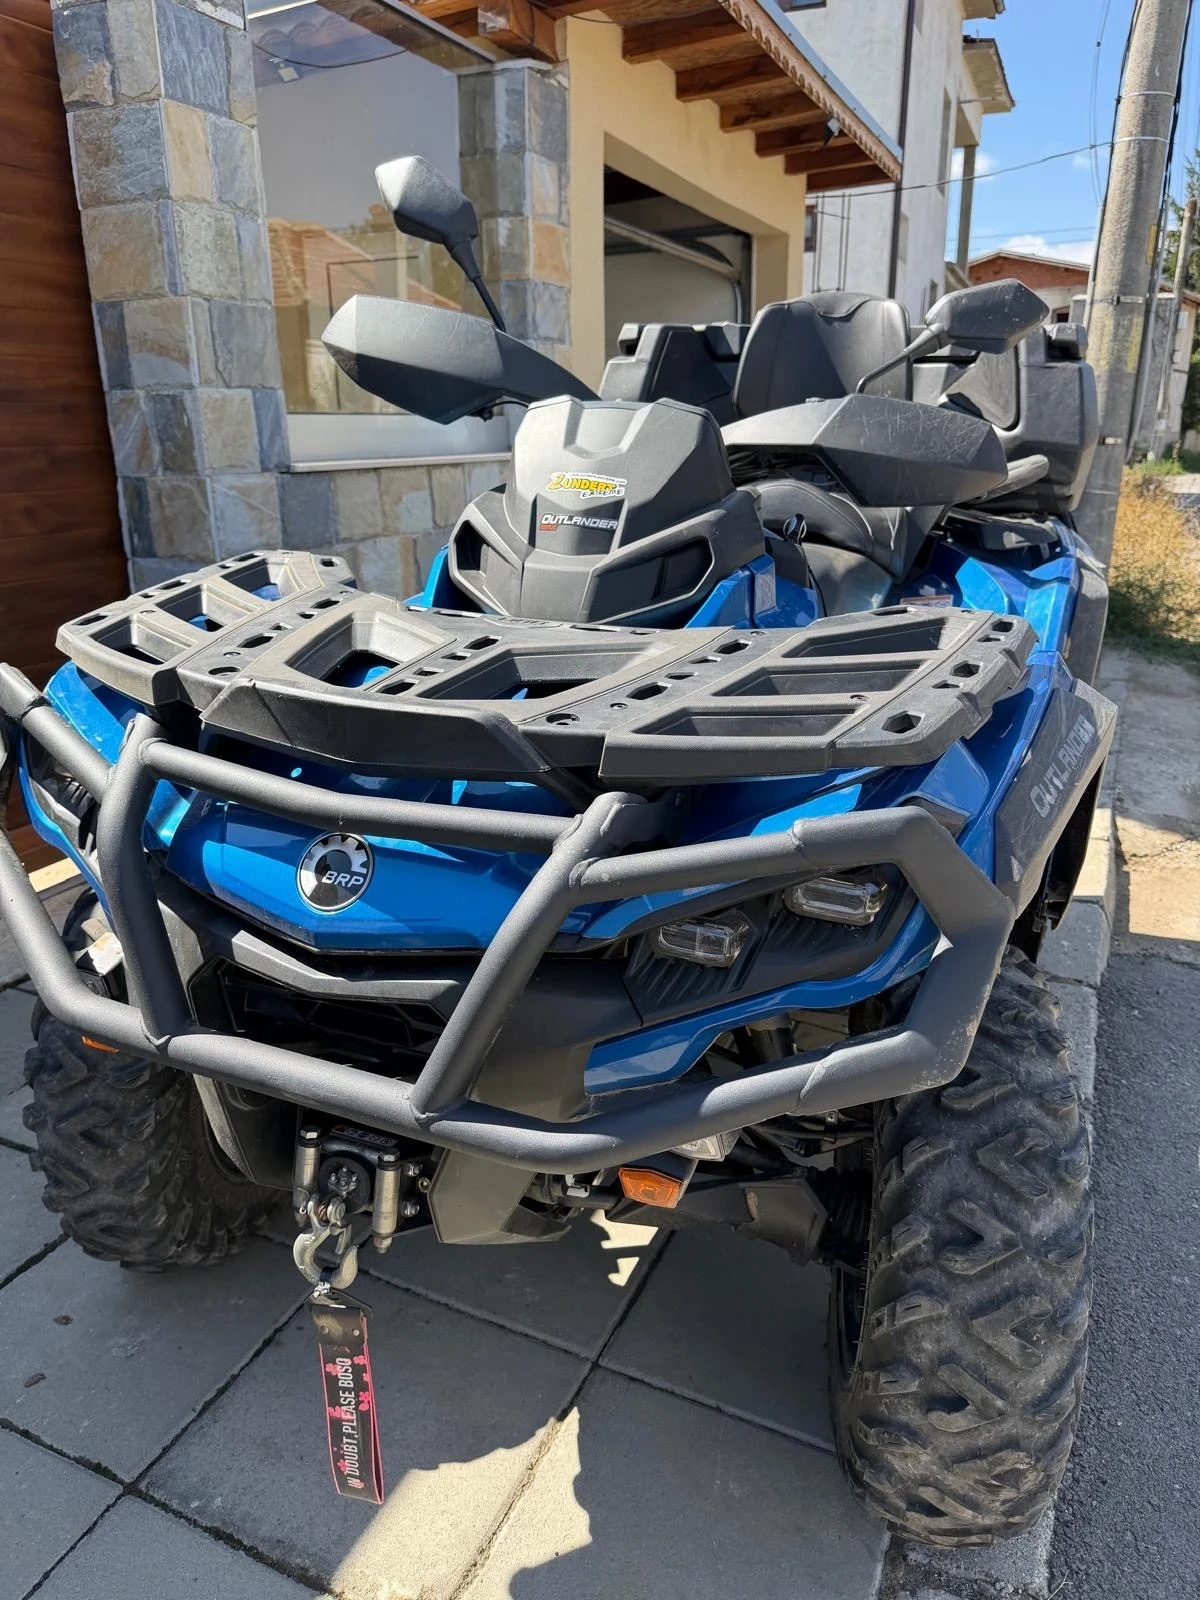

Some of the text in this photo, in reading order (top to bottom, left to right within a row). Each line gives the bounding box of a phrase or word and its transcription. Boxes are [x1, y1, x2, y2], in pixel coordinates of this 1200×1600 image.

[541, 514, 619, 530] OUTLANDER
[321, 870, 364, 888] BRP
[335, 1357, 354, 1388] BOSO
